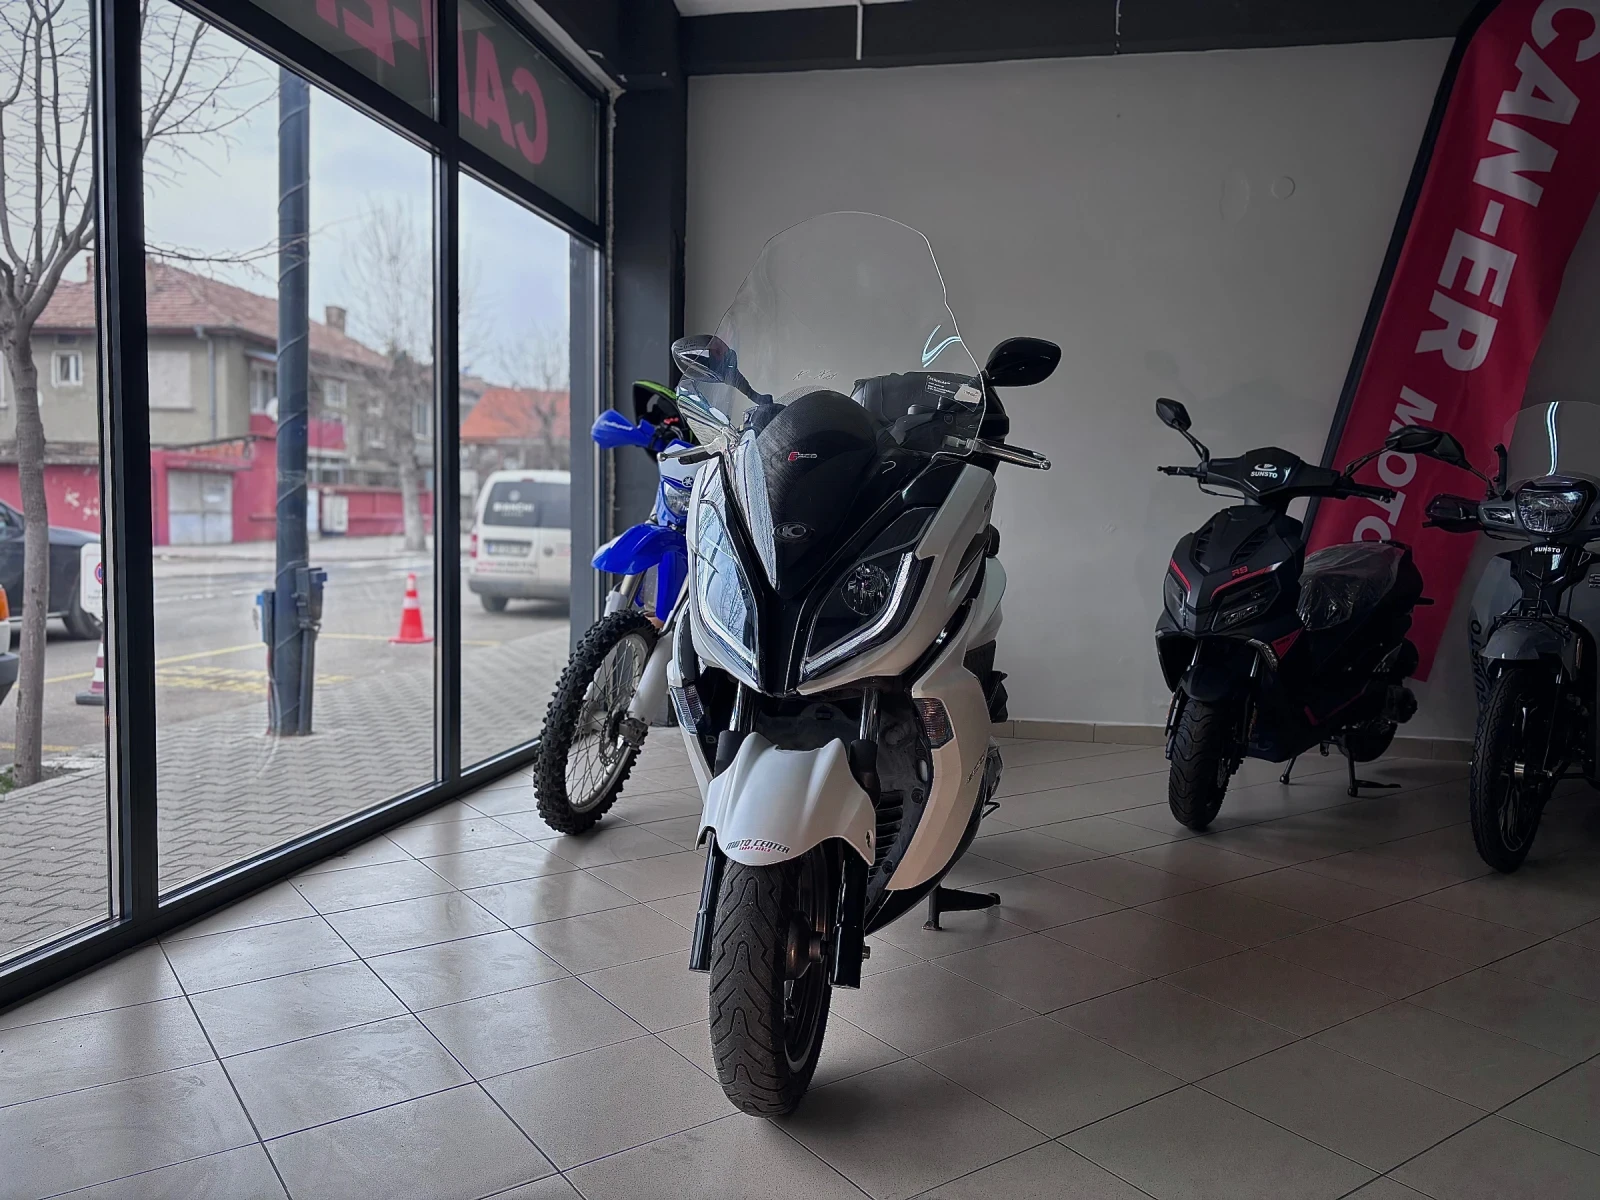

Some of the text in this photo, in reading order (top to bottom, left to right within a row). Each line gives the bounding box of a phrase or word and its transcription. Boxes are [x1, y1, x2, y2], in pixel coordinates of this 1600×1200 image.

[1415, 0, 1600, 372] CAN-ER
[1250, 471, 1278, 479] SUNSTO
[1533, 546, 1561, 554] SUNSTO
[754, 839, 790, 853] CENTER
